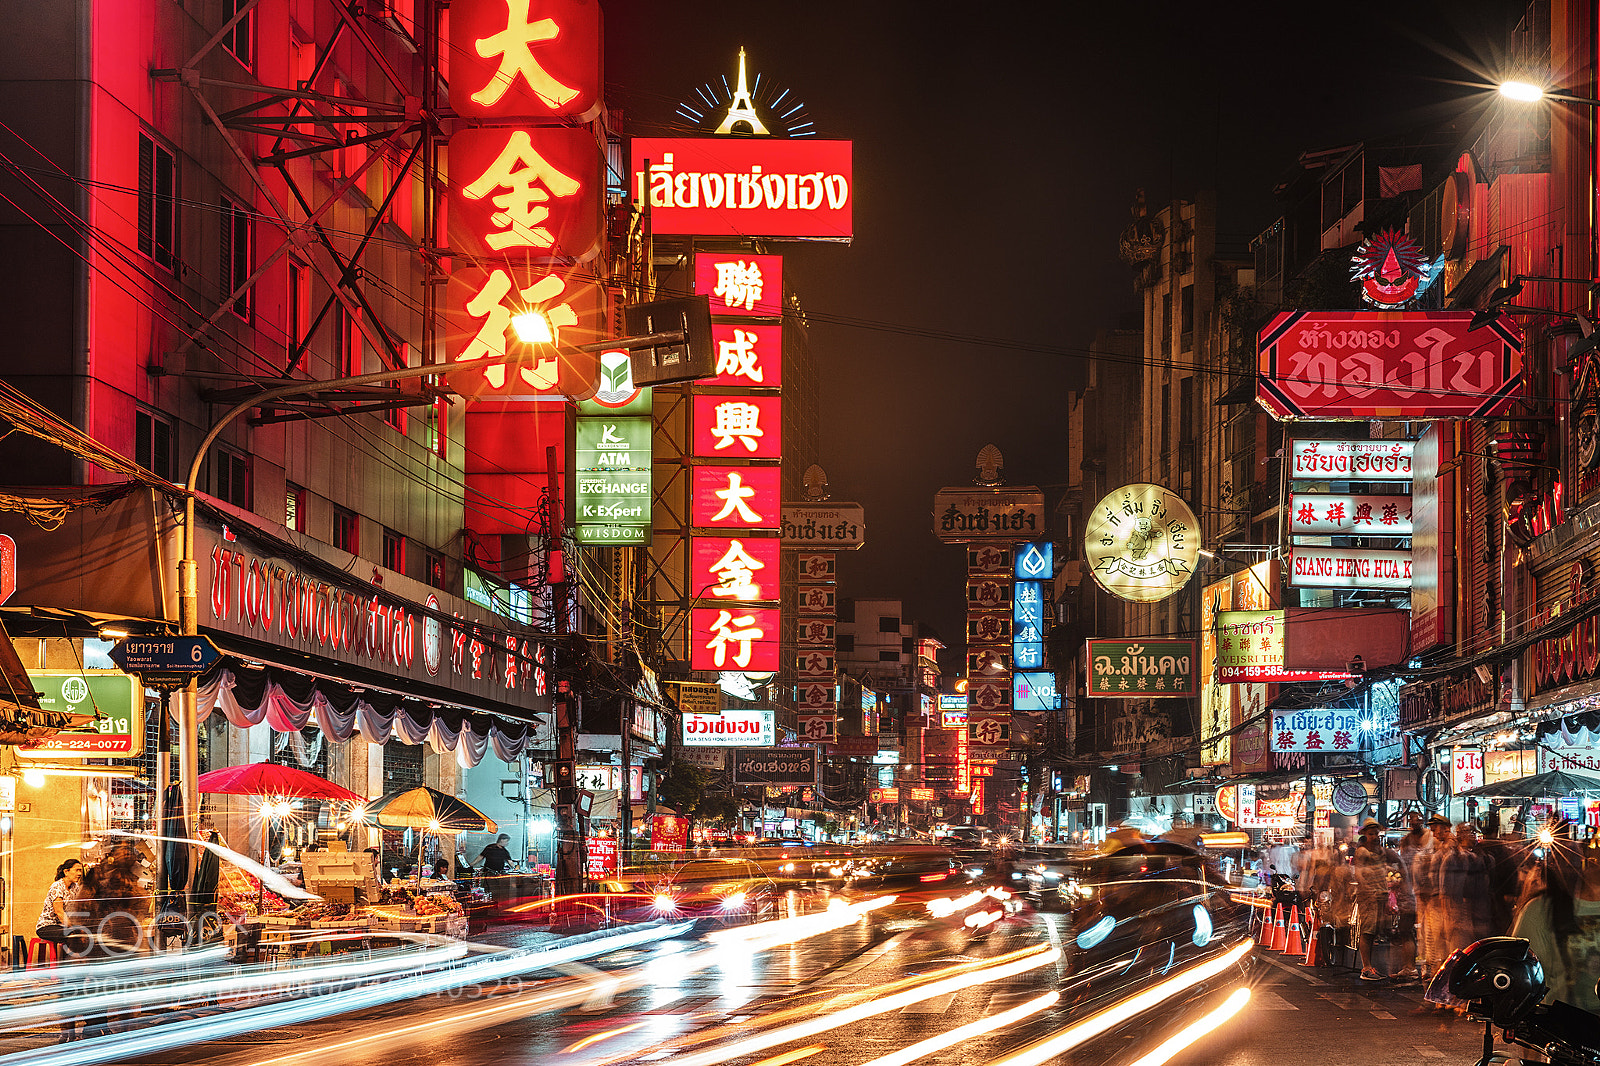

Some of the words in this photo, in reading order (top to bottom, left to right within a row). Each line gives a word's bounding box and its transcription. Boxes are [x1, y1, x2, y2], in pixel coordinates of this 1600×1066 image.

[455, 0, 581, 391] 大金行
[1298, 323, 1400, 349] ห้างทอง
[598, 452, 631, 465] ATM
[707, 260, 765, 668] 聯成興大金行
[579, 483, 648, 494] EXCHANGE
[583, 501, 642, 519] K-Expert
[1296, 502, 1412, 527] 林祥興藥
[582, 529, 645, 538] WISDOM
[1295, 556, 1333, 577] SIANG
[1335, 558, 1371, 578] HENG
[1373, 559, 1400, 579] HUA
[1223, 615, 1275, 636] เวชศรี
[125, 642, 174, 654] เยาวราช
[190, 644, 202, 663] 6
[1094, 643, 1190, 675] ฉ.มั่นคง
[1222, 655, 1258, 665] VEJSRI
[681, 686, 717, 695] แสงอรุณ
[47, 740, 127, 749] 02-224-0077
[1275, 730, 1354, 750] 蔡益發
